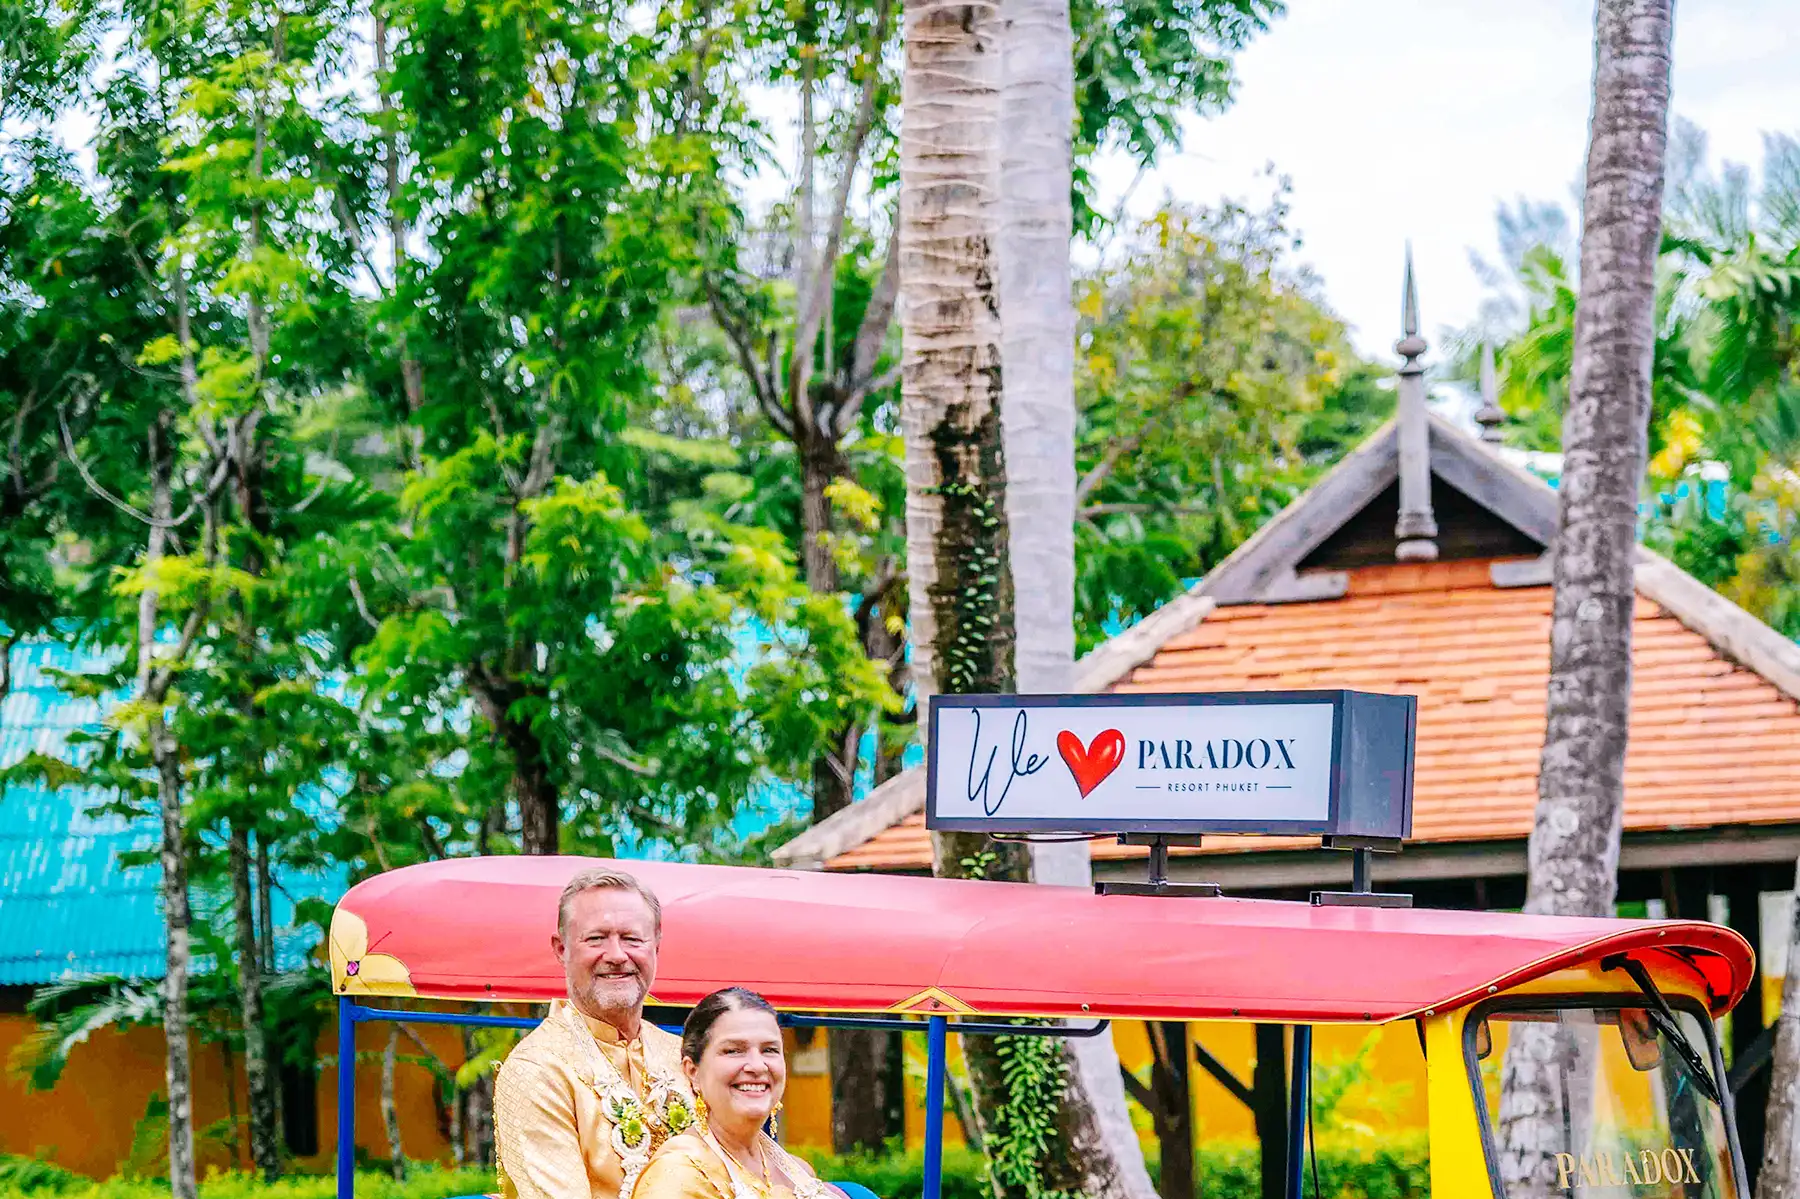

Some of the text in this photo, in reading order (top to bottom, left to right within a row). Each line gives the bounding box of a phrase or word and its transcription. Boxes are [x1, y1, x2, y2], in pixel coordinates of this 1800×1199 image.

[967, 706, 1297, 817] We PARADOX
[1167, 782, 1260, 792] RESORT PHUKET
[1554, 1148, 1701, 1189] PARADOX
